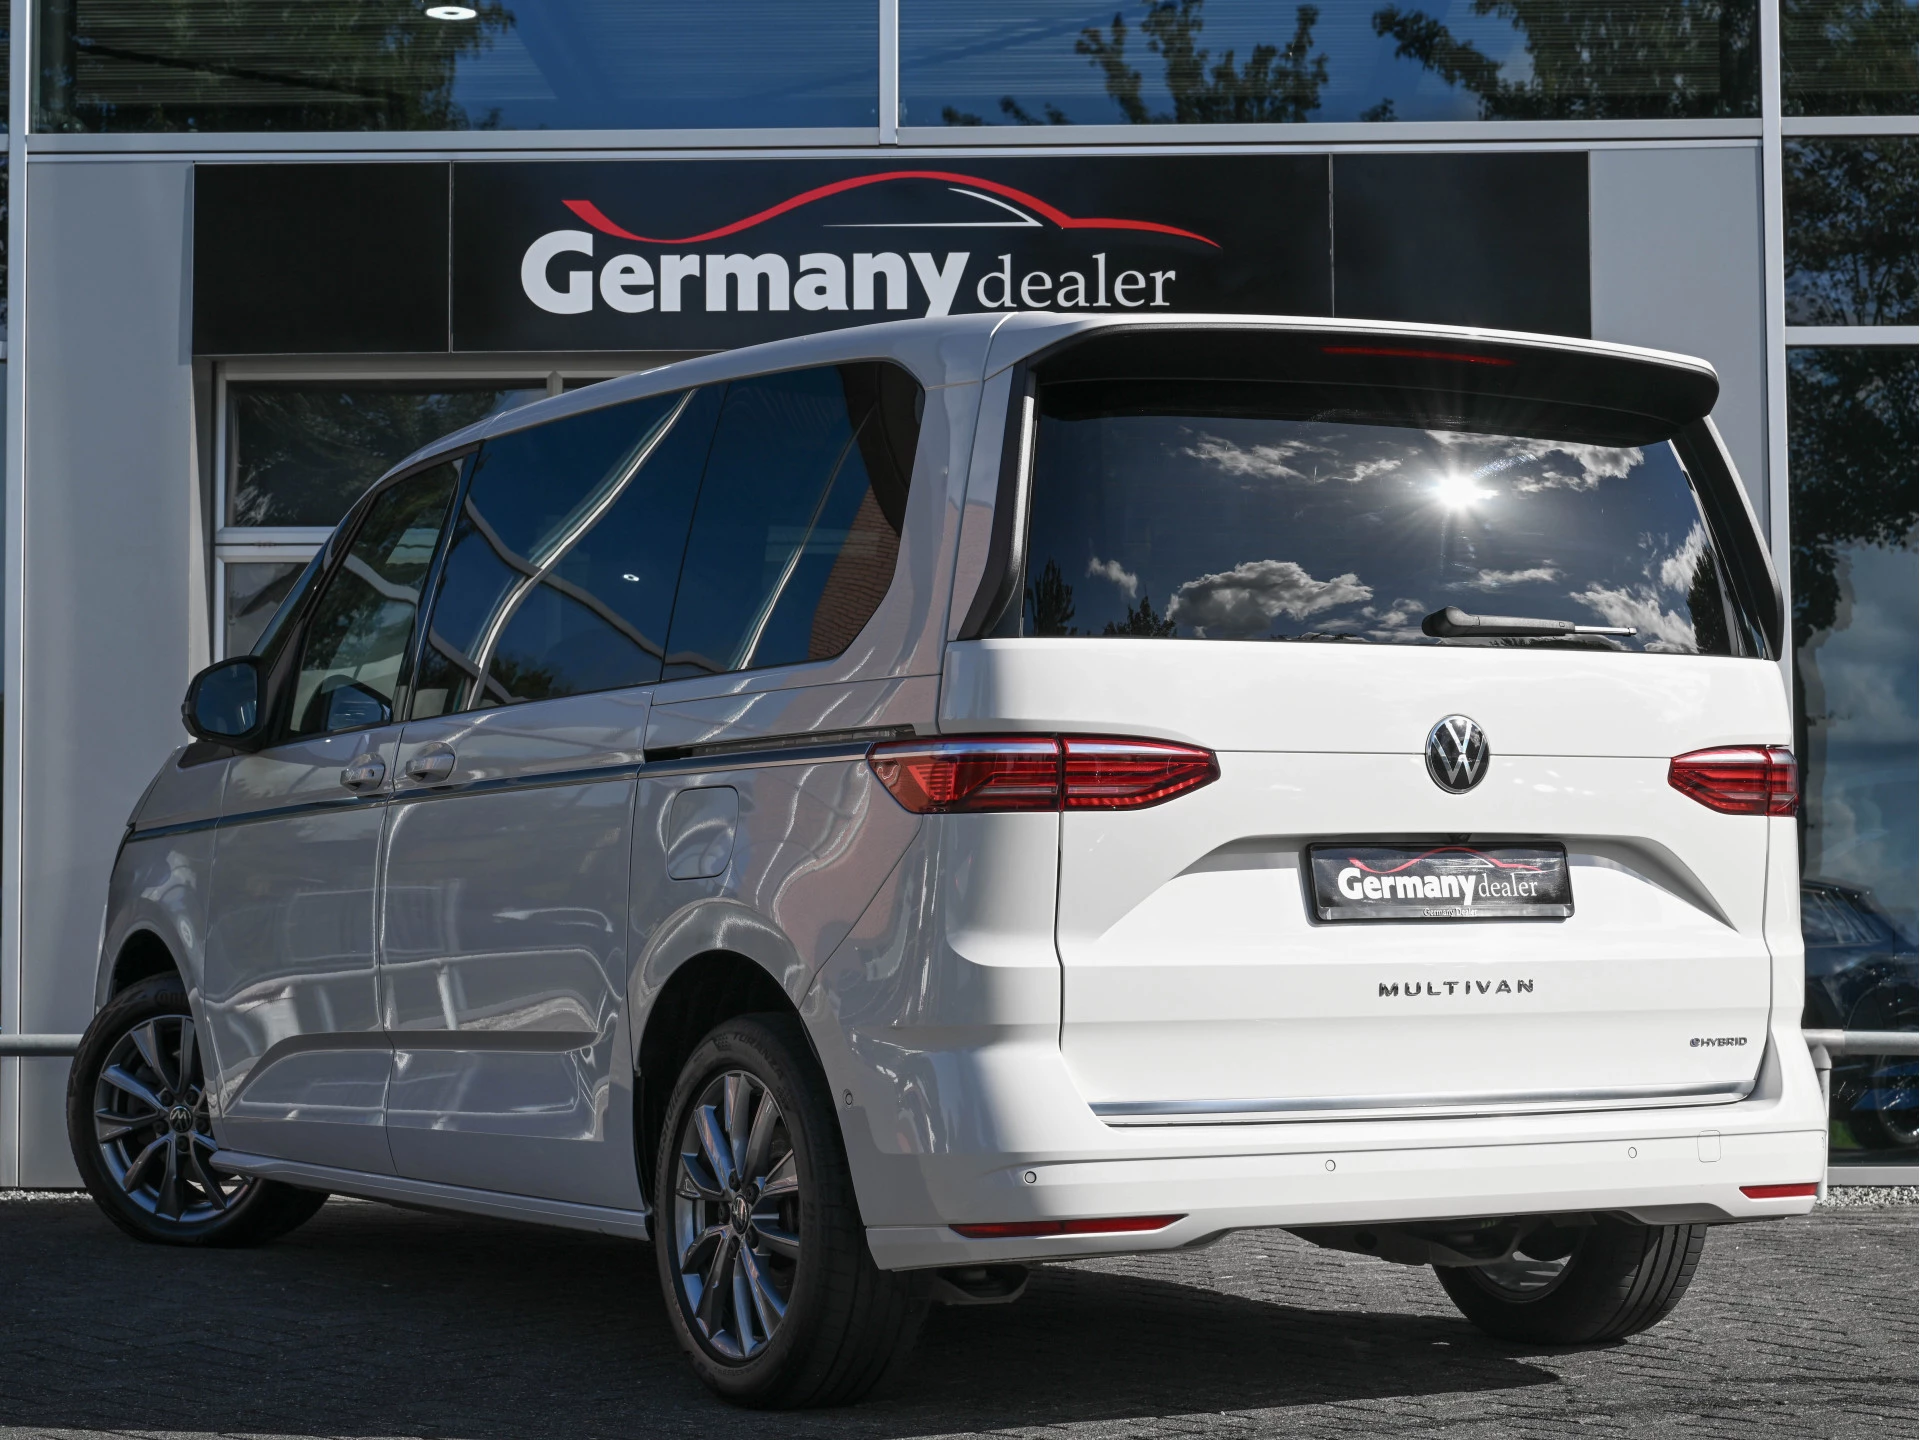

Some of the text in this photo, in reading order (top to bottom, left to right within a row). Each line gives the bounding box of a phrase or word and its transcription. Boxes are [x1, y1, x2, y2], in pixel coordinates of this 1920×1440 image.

[521, 230, 1176, 319] Germany dealer
[1337, 867, 1538, 906] Germany dealer
[1423, 906, 1478, 918] Germany Dealer
[1378, 978, 1535, 997] MULTIVAN
